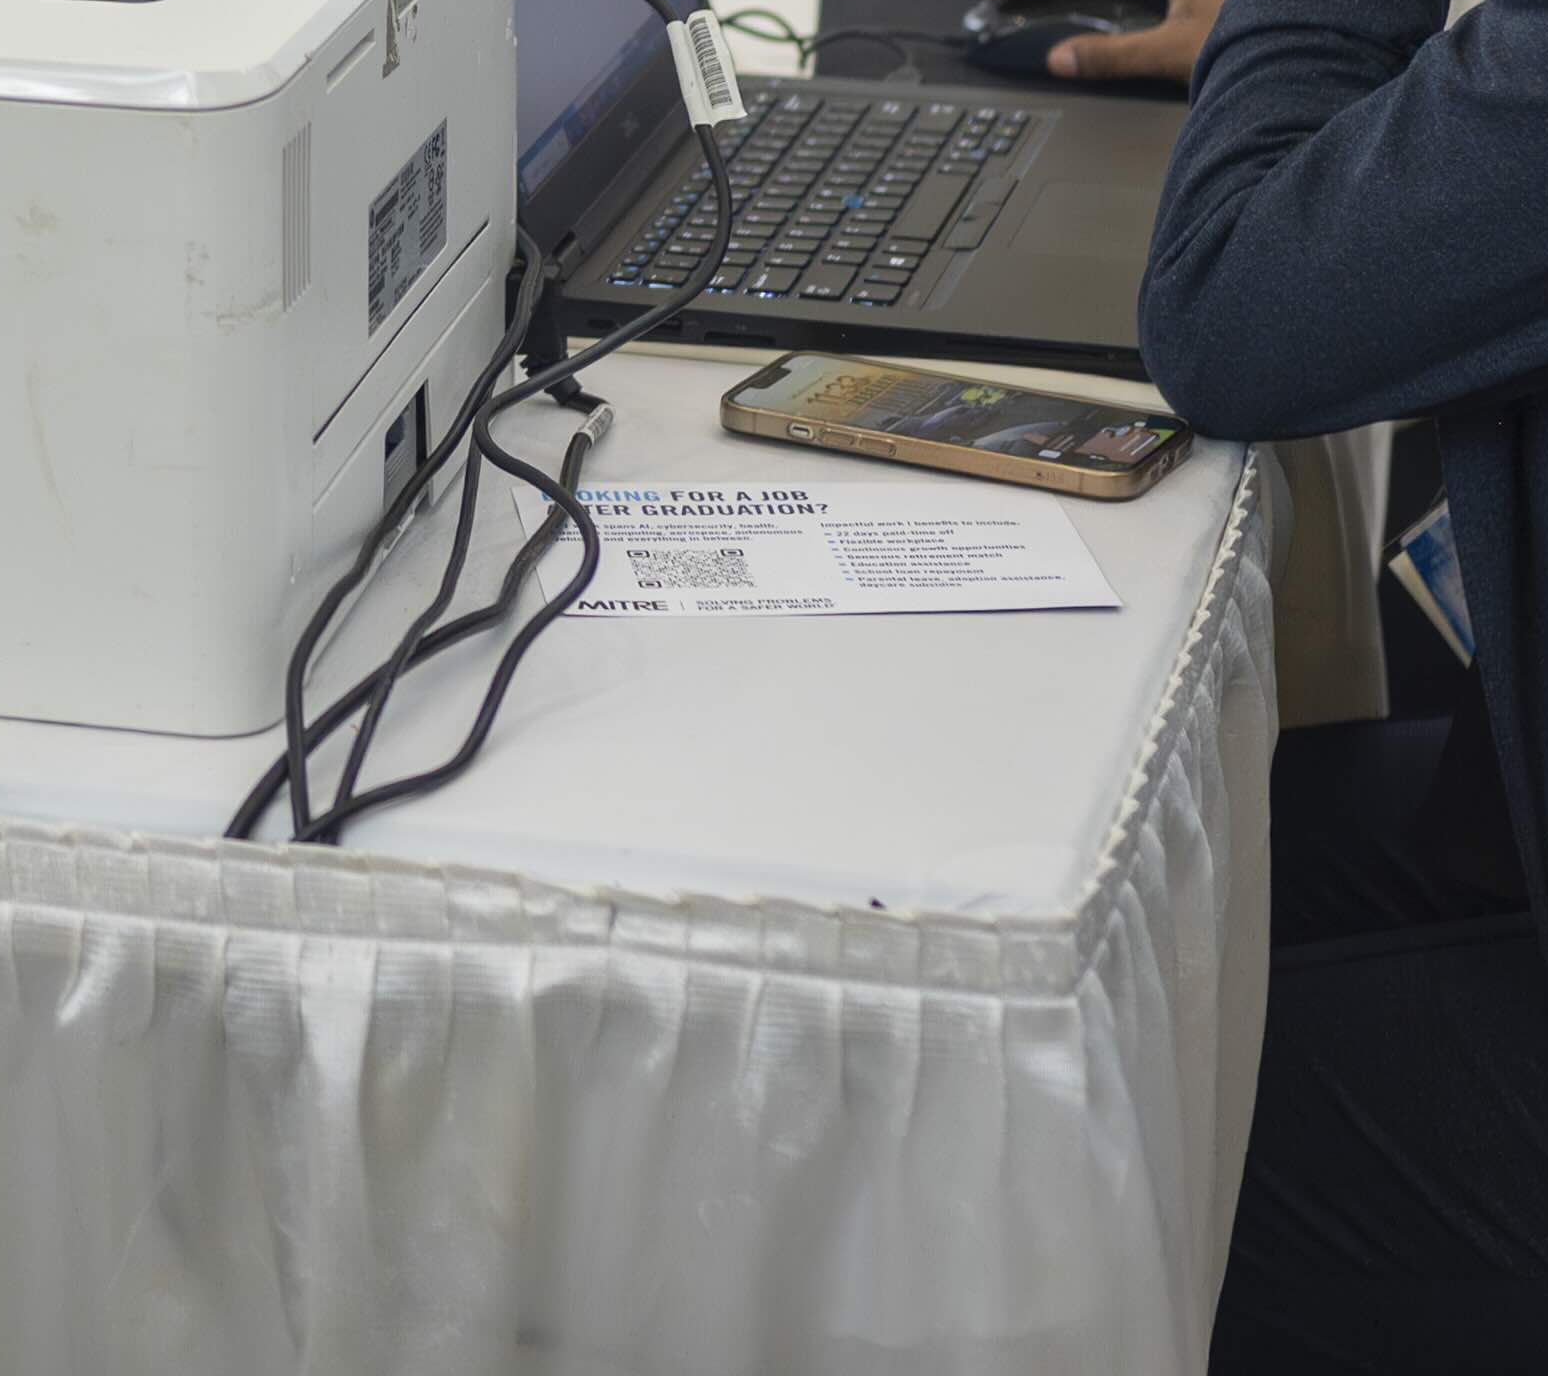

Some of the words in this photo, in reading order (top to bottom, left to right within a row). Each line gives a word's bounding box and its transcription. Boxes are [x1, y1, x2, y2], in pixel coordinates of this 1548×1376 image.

[541, 490, 661, 502] LOKING
[670, 490, 725, 502] FOR
[736, 491, 753, 502] A
[761, 490, 809, 502] JOB
[641, 504, 829, 516] GRADUATION?
[577, 600, 669, 611] MITRE
